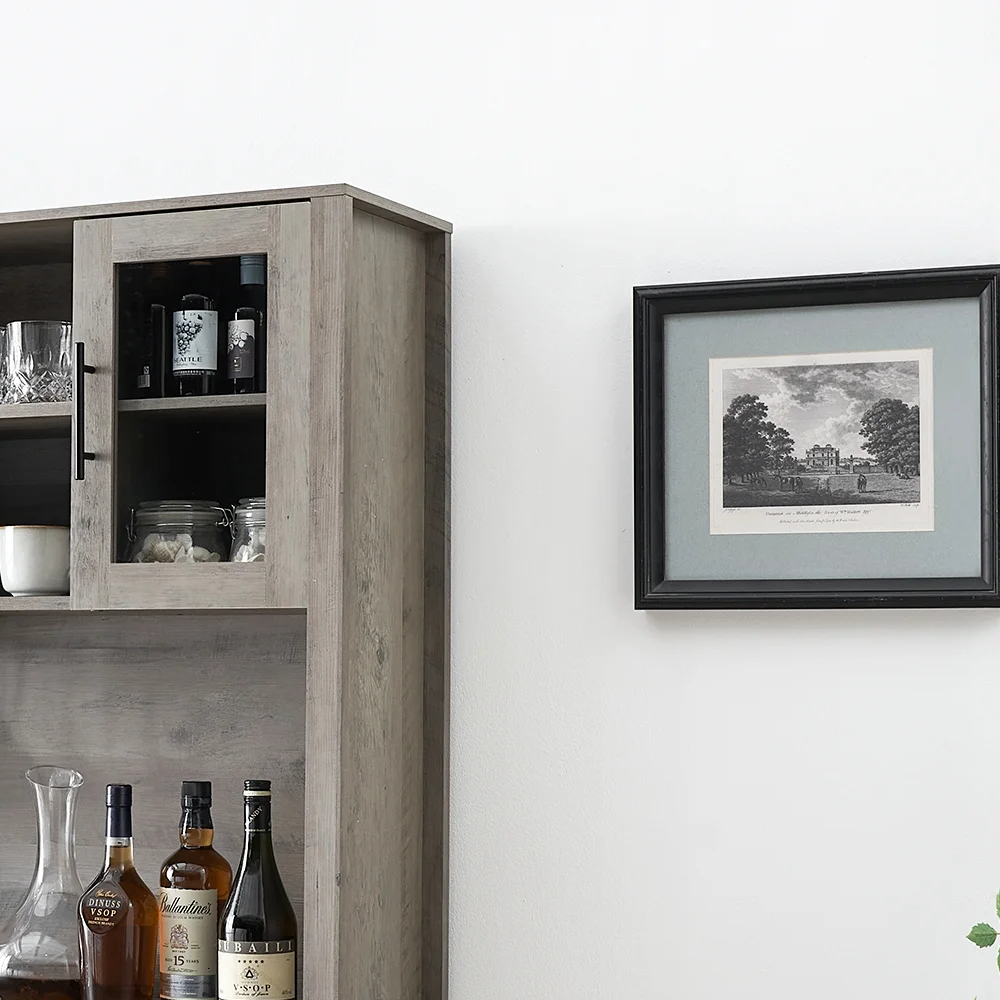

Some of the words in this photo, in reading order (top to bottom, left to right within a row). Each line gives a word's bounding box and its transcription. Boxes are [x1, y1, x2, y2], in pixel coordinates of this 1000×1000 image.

[89, 898, 121, 909] DINUSS
[90, 907, 117, 917] VSOP
[174, 955, 185, 966] 15
